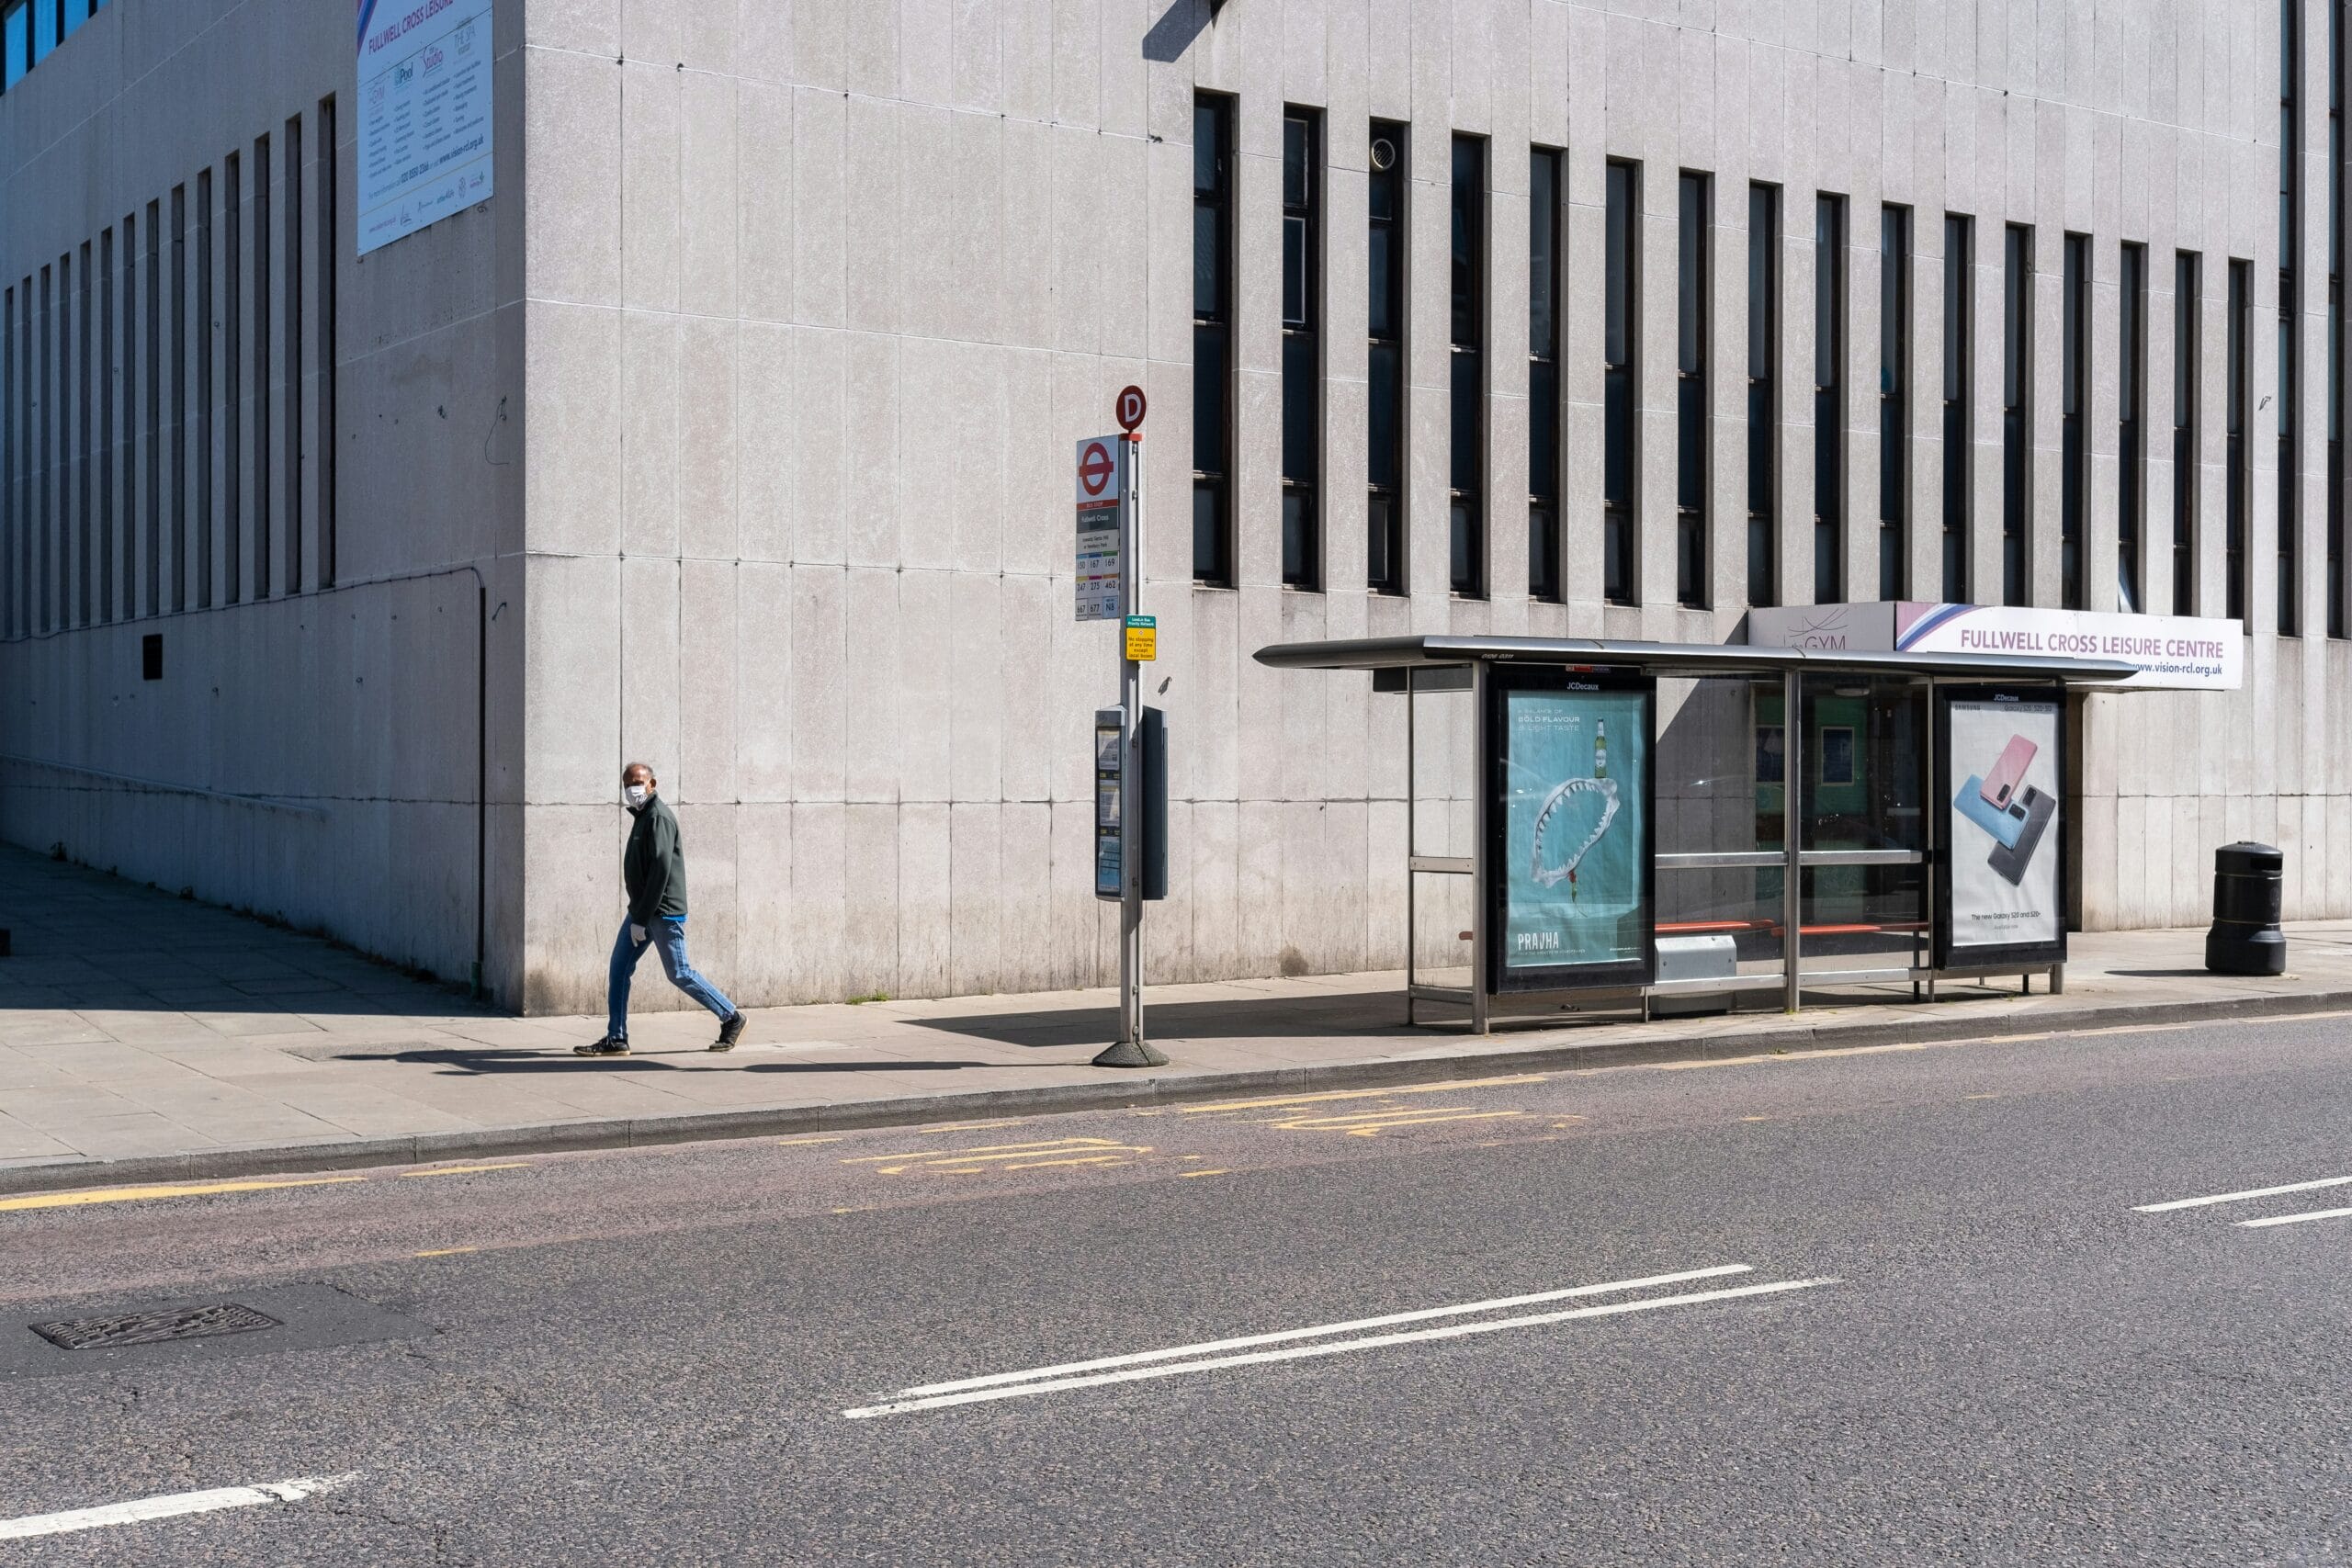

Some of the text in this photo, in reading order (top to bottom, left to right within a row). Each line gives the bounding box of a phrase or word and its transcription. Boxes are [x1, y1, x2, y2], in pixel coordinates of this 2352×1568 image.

[368, 22, 401, 55] FULLWELL
[401, 6, 424, 34] CROSS
[400, 62, 413, 83] Pool
[1124, 393, 1142, 423] D
[1090, 559, 1100, 569] 167
[1105, 558, 1115, 567] 169
[1091, 581, 1101, 591] 275
[1105, 581, 1116, 589] 462
[1090, 604, 1100, 613] 677
[1804, 635, 1846, 650] GYM
[1961, 629, 2223, 659] FULLWELL CROSS LEISURE CENTRE
[2132, 662, 2222, 677] ww.vision-rcl.org.uk
[1994, 694, 2018, 702] JCDecaux
[1518, 931, 1559, 951] PRAVHA
